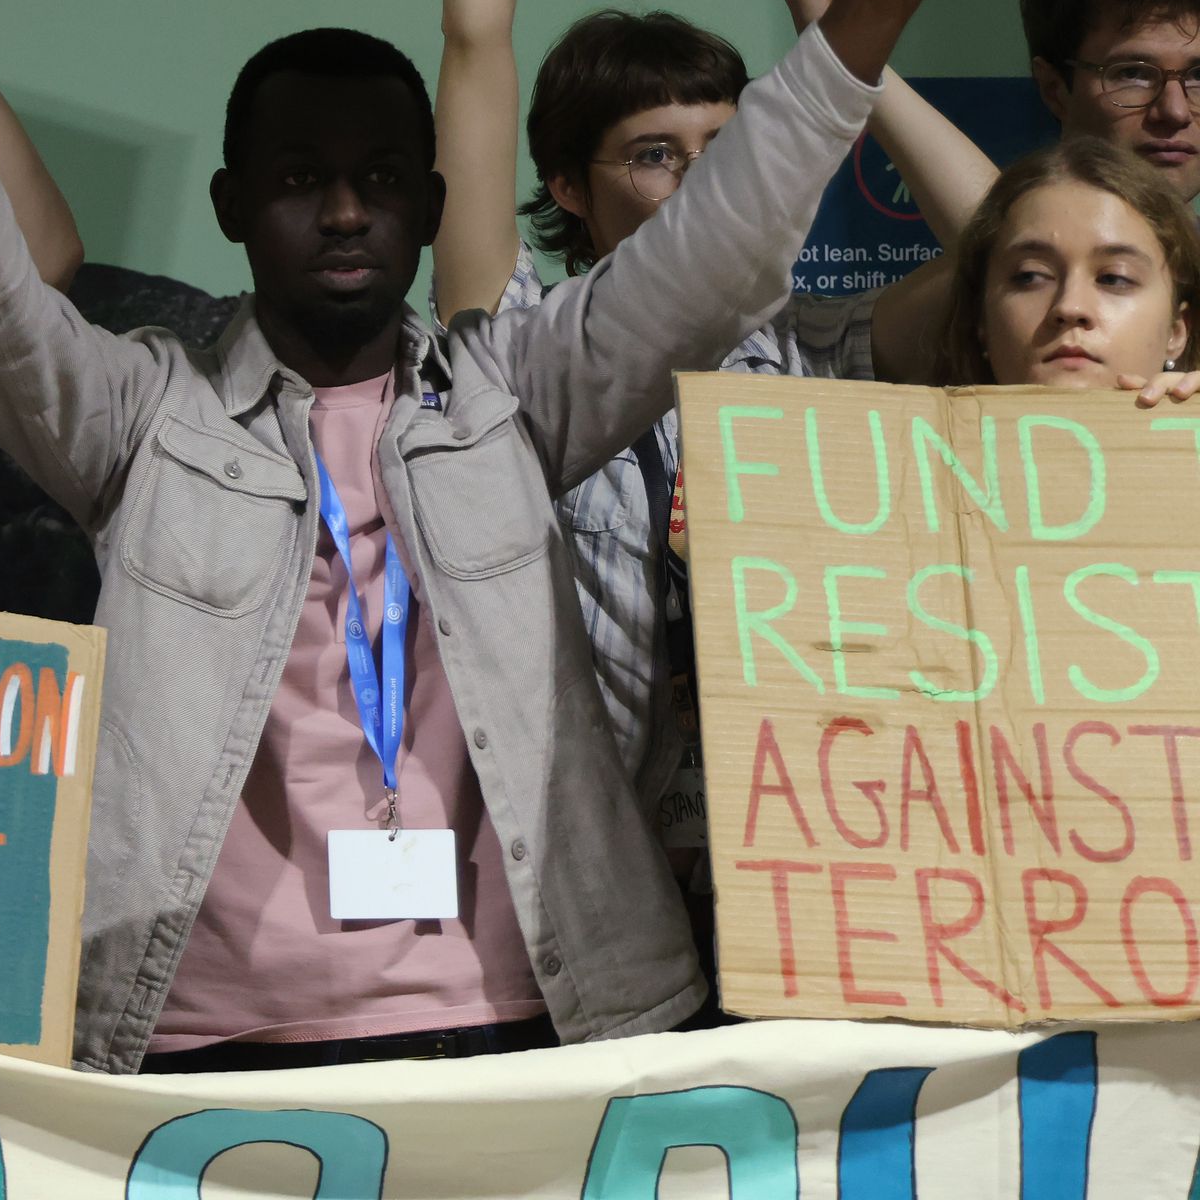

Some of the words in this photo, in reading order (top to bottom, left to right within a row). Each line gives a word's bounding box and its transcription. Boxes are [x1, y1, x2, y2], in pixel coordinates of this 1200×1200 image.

[795, 244, 819, 262] ot
[824, 244, 873, 262] lean.
[816, 274, 838, 289] or
[842, 270, 887, 289] shift
[719, 406, 1106, 541] FUND
[743, 716, 1200, 864] AGAINST
[735, 859, 1198, 1014] TERRO
